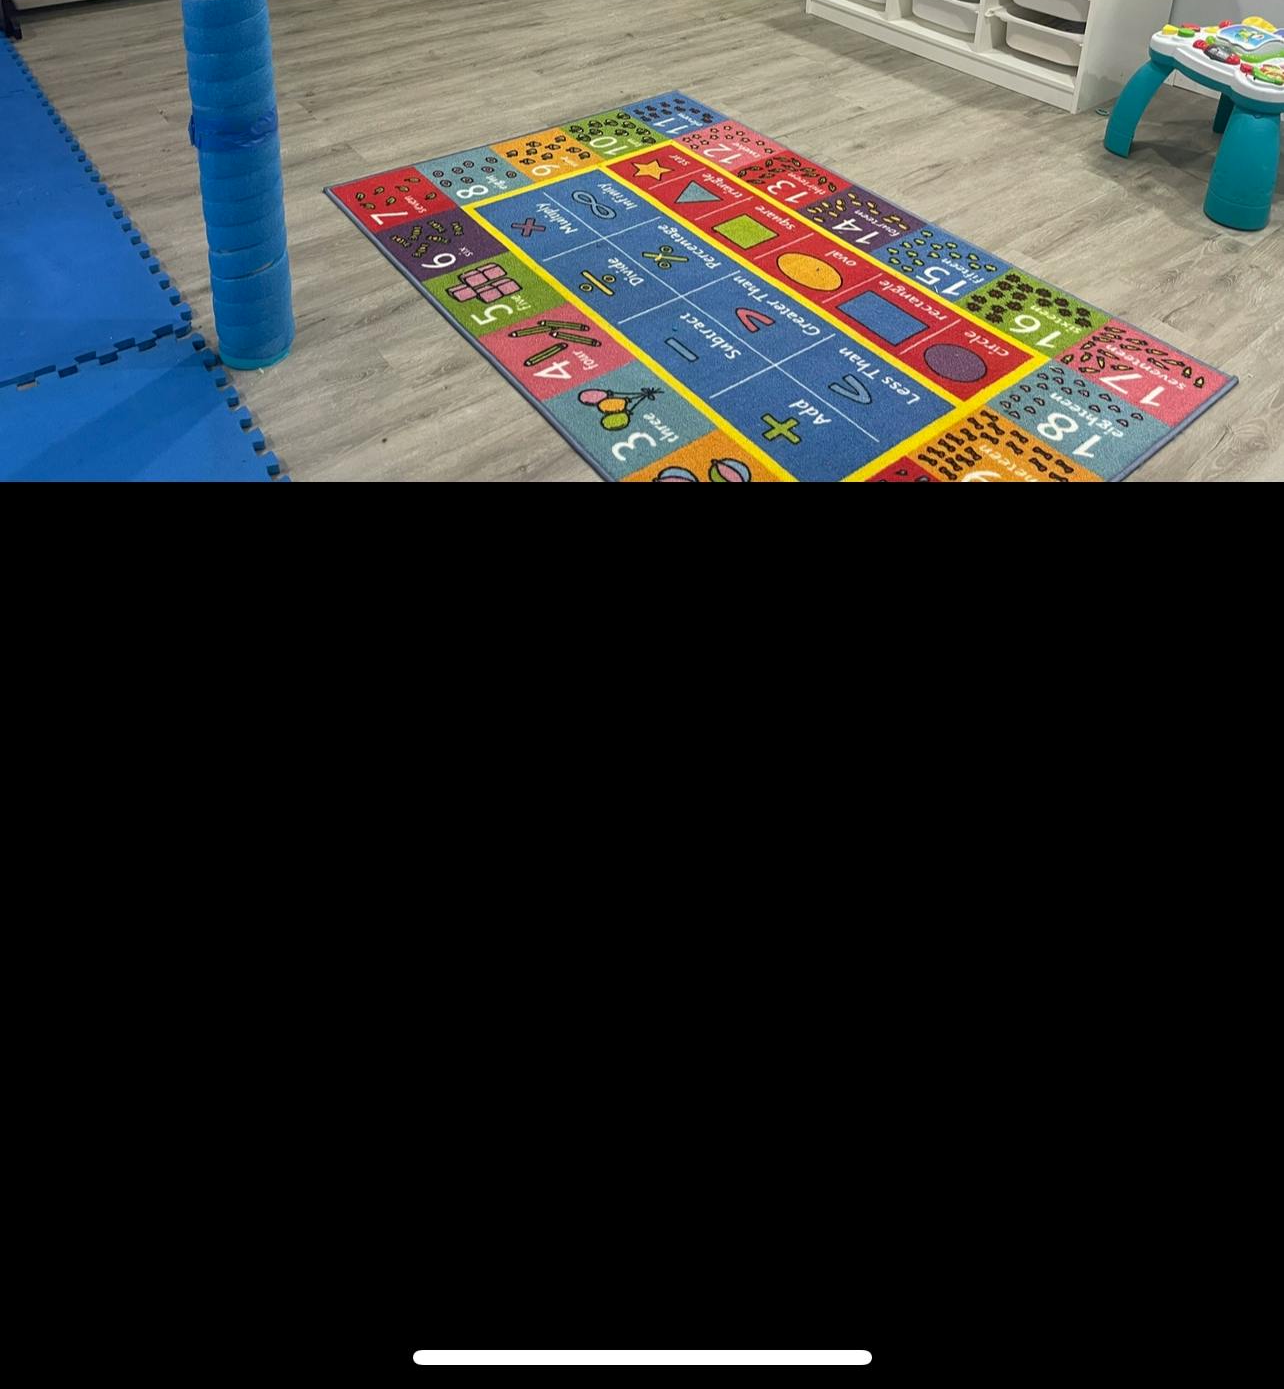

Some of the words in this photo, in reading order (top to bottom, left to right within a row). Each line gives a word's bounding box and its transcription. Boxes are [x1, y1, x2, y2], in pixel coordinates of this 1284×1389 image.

[653, 117, 689, 135] 11
[589, 136, 628, 156] 10
[703, 143, 742, 165] 12
[531, 164, 561, 177] 9
[669, 154, 691, 167] star
[456, 184, 489, 199] 8
[597, 183, 638, 210] Infinity
[702, 173, 742, 199] triangle
[767, 179, 808, 204] 13
[787, 172, 826, 196] thirteen
[370, 211, 409, 225] 7
[404, 195, 428, 214] seven
[755, 204, 796, 231] square
[536, 203, 578, 235] Multiply
[832, 218, 879, 245] 14
[854, 209, 900, 238] fourteen
[421, 253, 457, 269] 6
[459, 246, 474, 258] six
[657, 224, 721, 271] Percentage
[825, 249, 857, 267] oval
[607, 257, 645, 287] Divide
[915, 266, 968, 297] 15
[733, 274, 768, 303] Than
[878, 279, 948, 322] rectangle
[470, 303, 514, 327] 5
[767, 300, 821, 337] Greater
[1030, 304, 1082, 335] sixteen
[680, 312, 741, 360] Subtract
[964, 330, 1010, 357] circle
[1009, 314, 1062, 349] 16
[533, 359, 573, 381] 4
[839, 346, 881, 380] Than
[1105, 343, 1187, 391] seventeen
[881, 376, 921, 406] Less
[1099, 373, 1166, 408] 17
[788, 398, 833, 426] Add
[1049, 391, 1125, 439] eighteen
[643, 412, 680, 444] three
[1036, 412, 1103, 459] 18
[611, 432, 657, 462] 3
